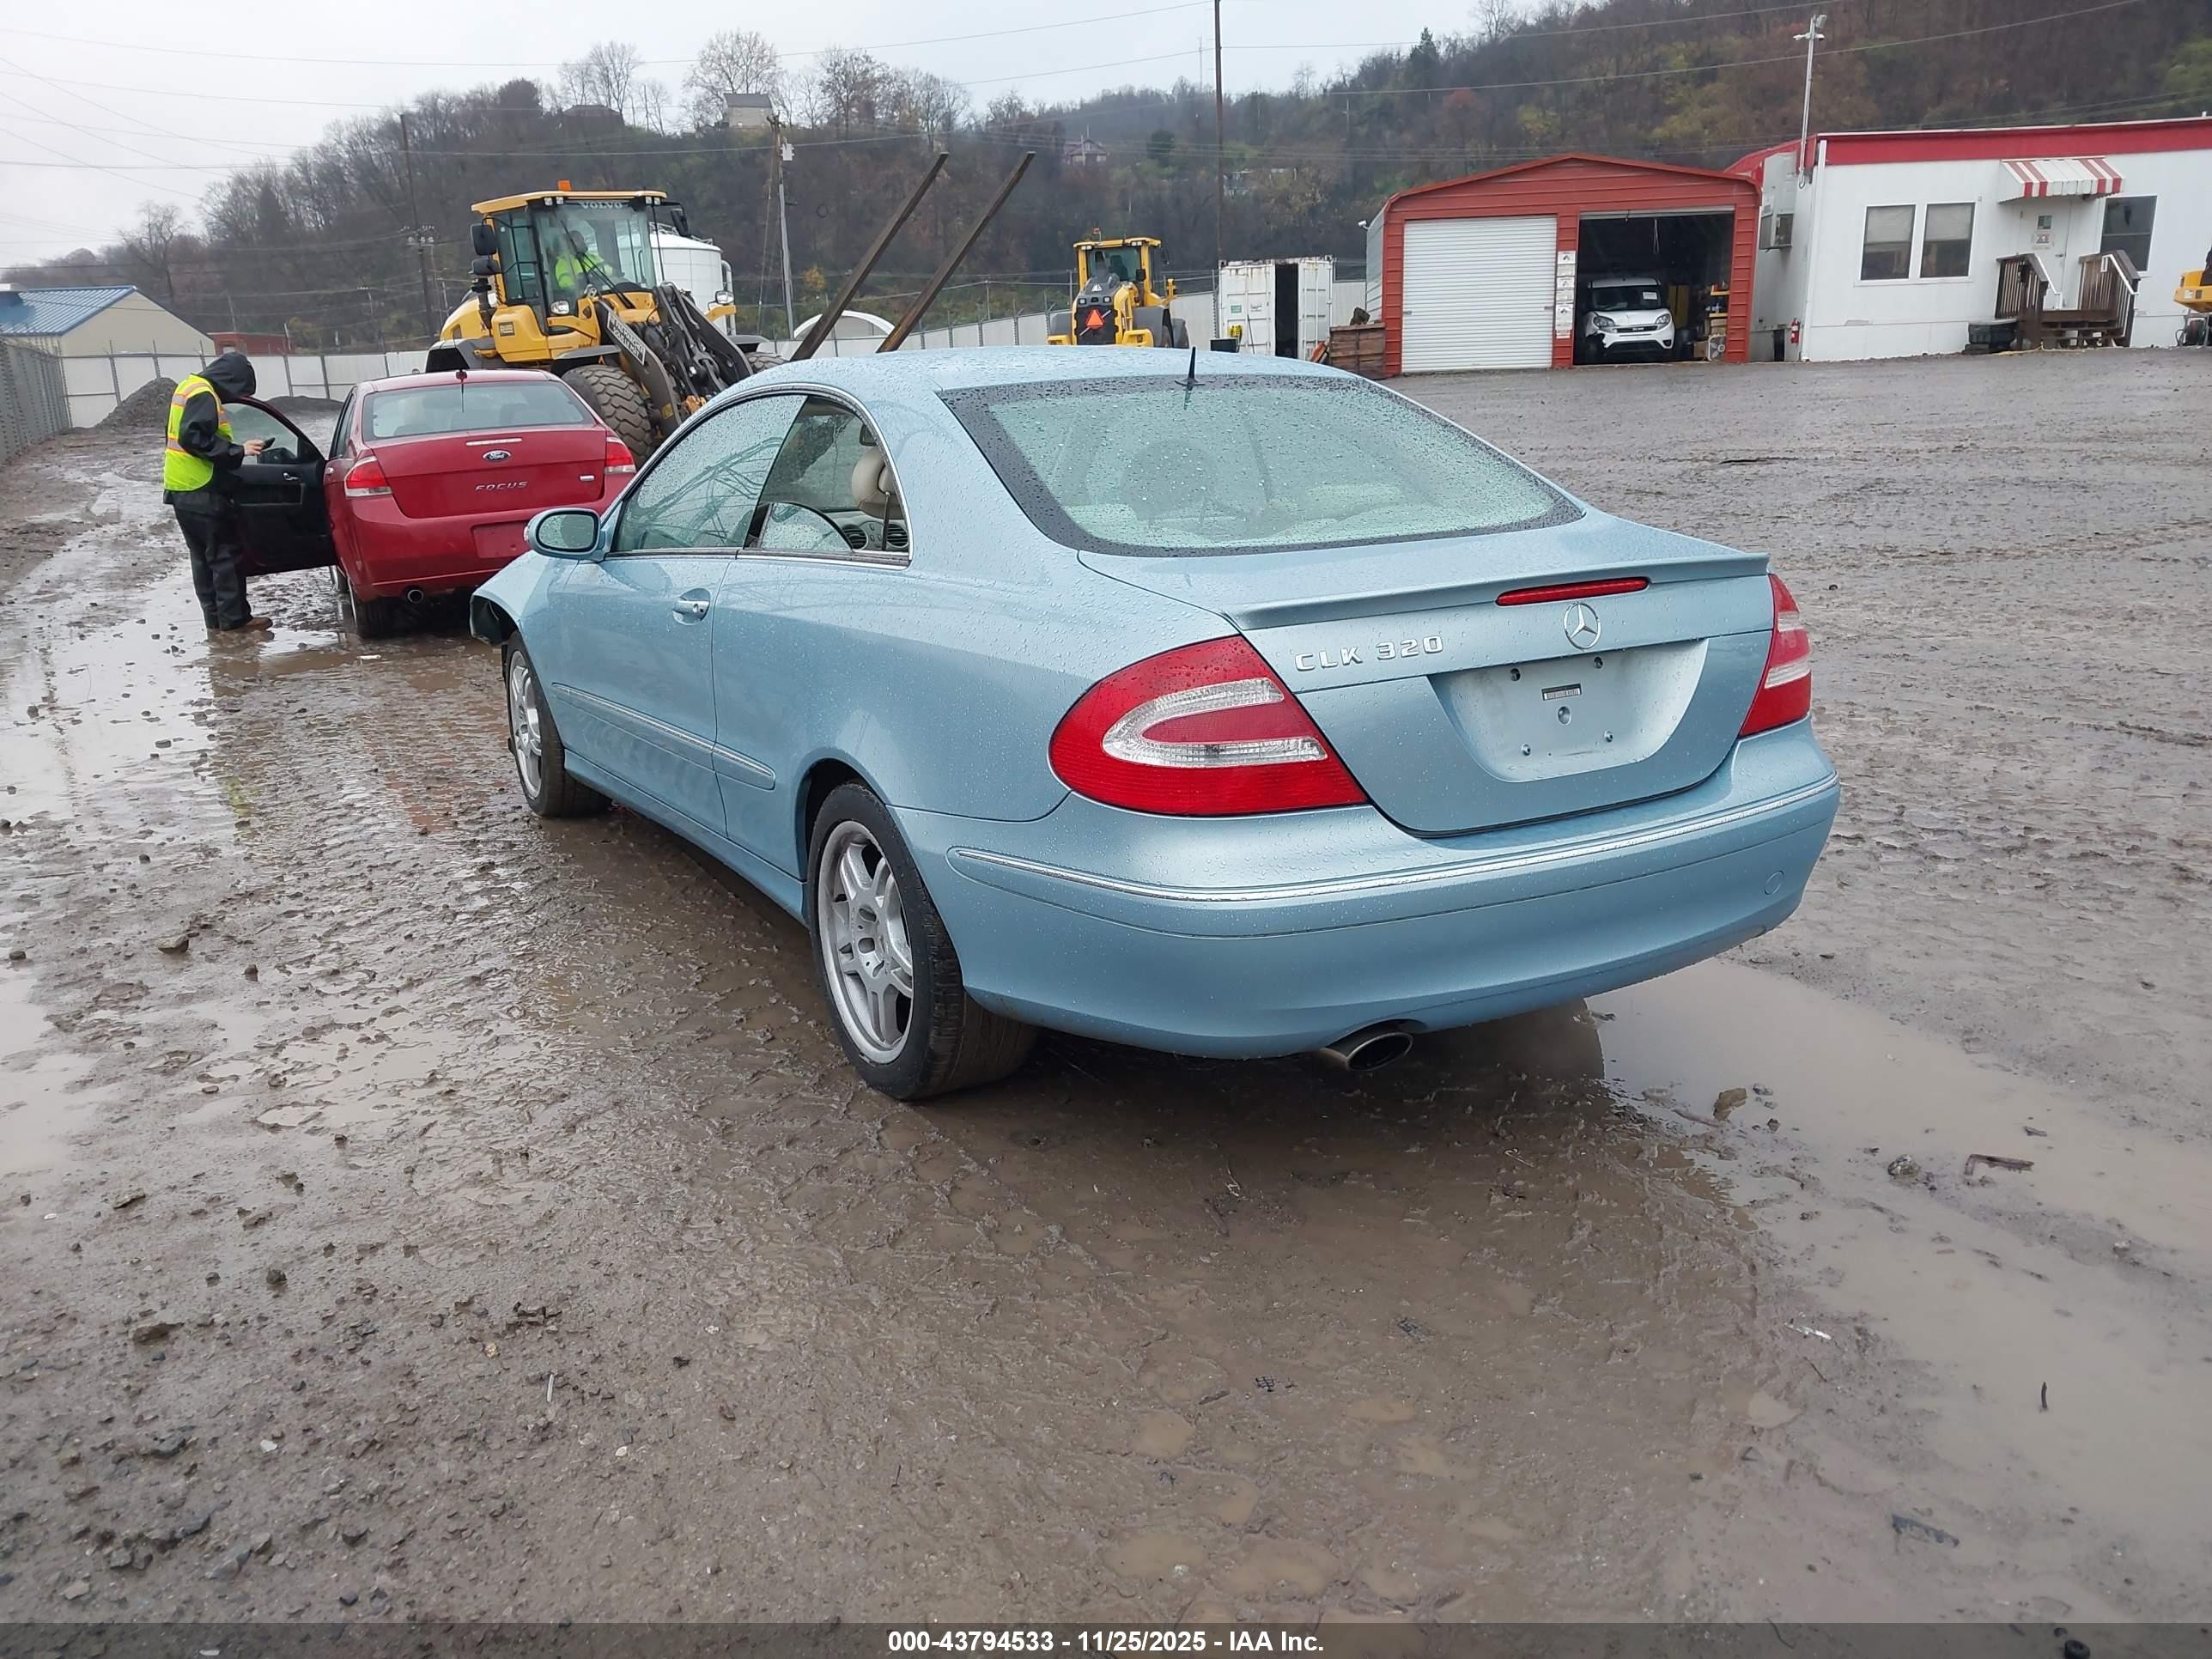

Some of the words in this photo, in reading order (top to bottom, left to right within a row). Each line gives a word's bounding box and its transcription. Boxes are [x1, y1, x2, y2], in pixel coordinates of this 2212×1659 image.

[580, 200, 623, 210] VOLVO
[475, 481, 529, 492] FOCUS
[1294, 646, 1364, 672] CLK
[1376, 635, 1444, 660] 320
